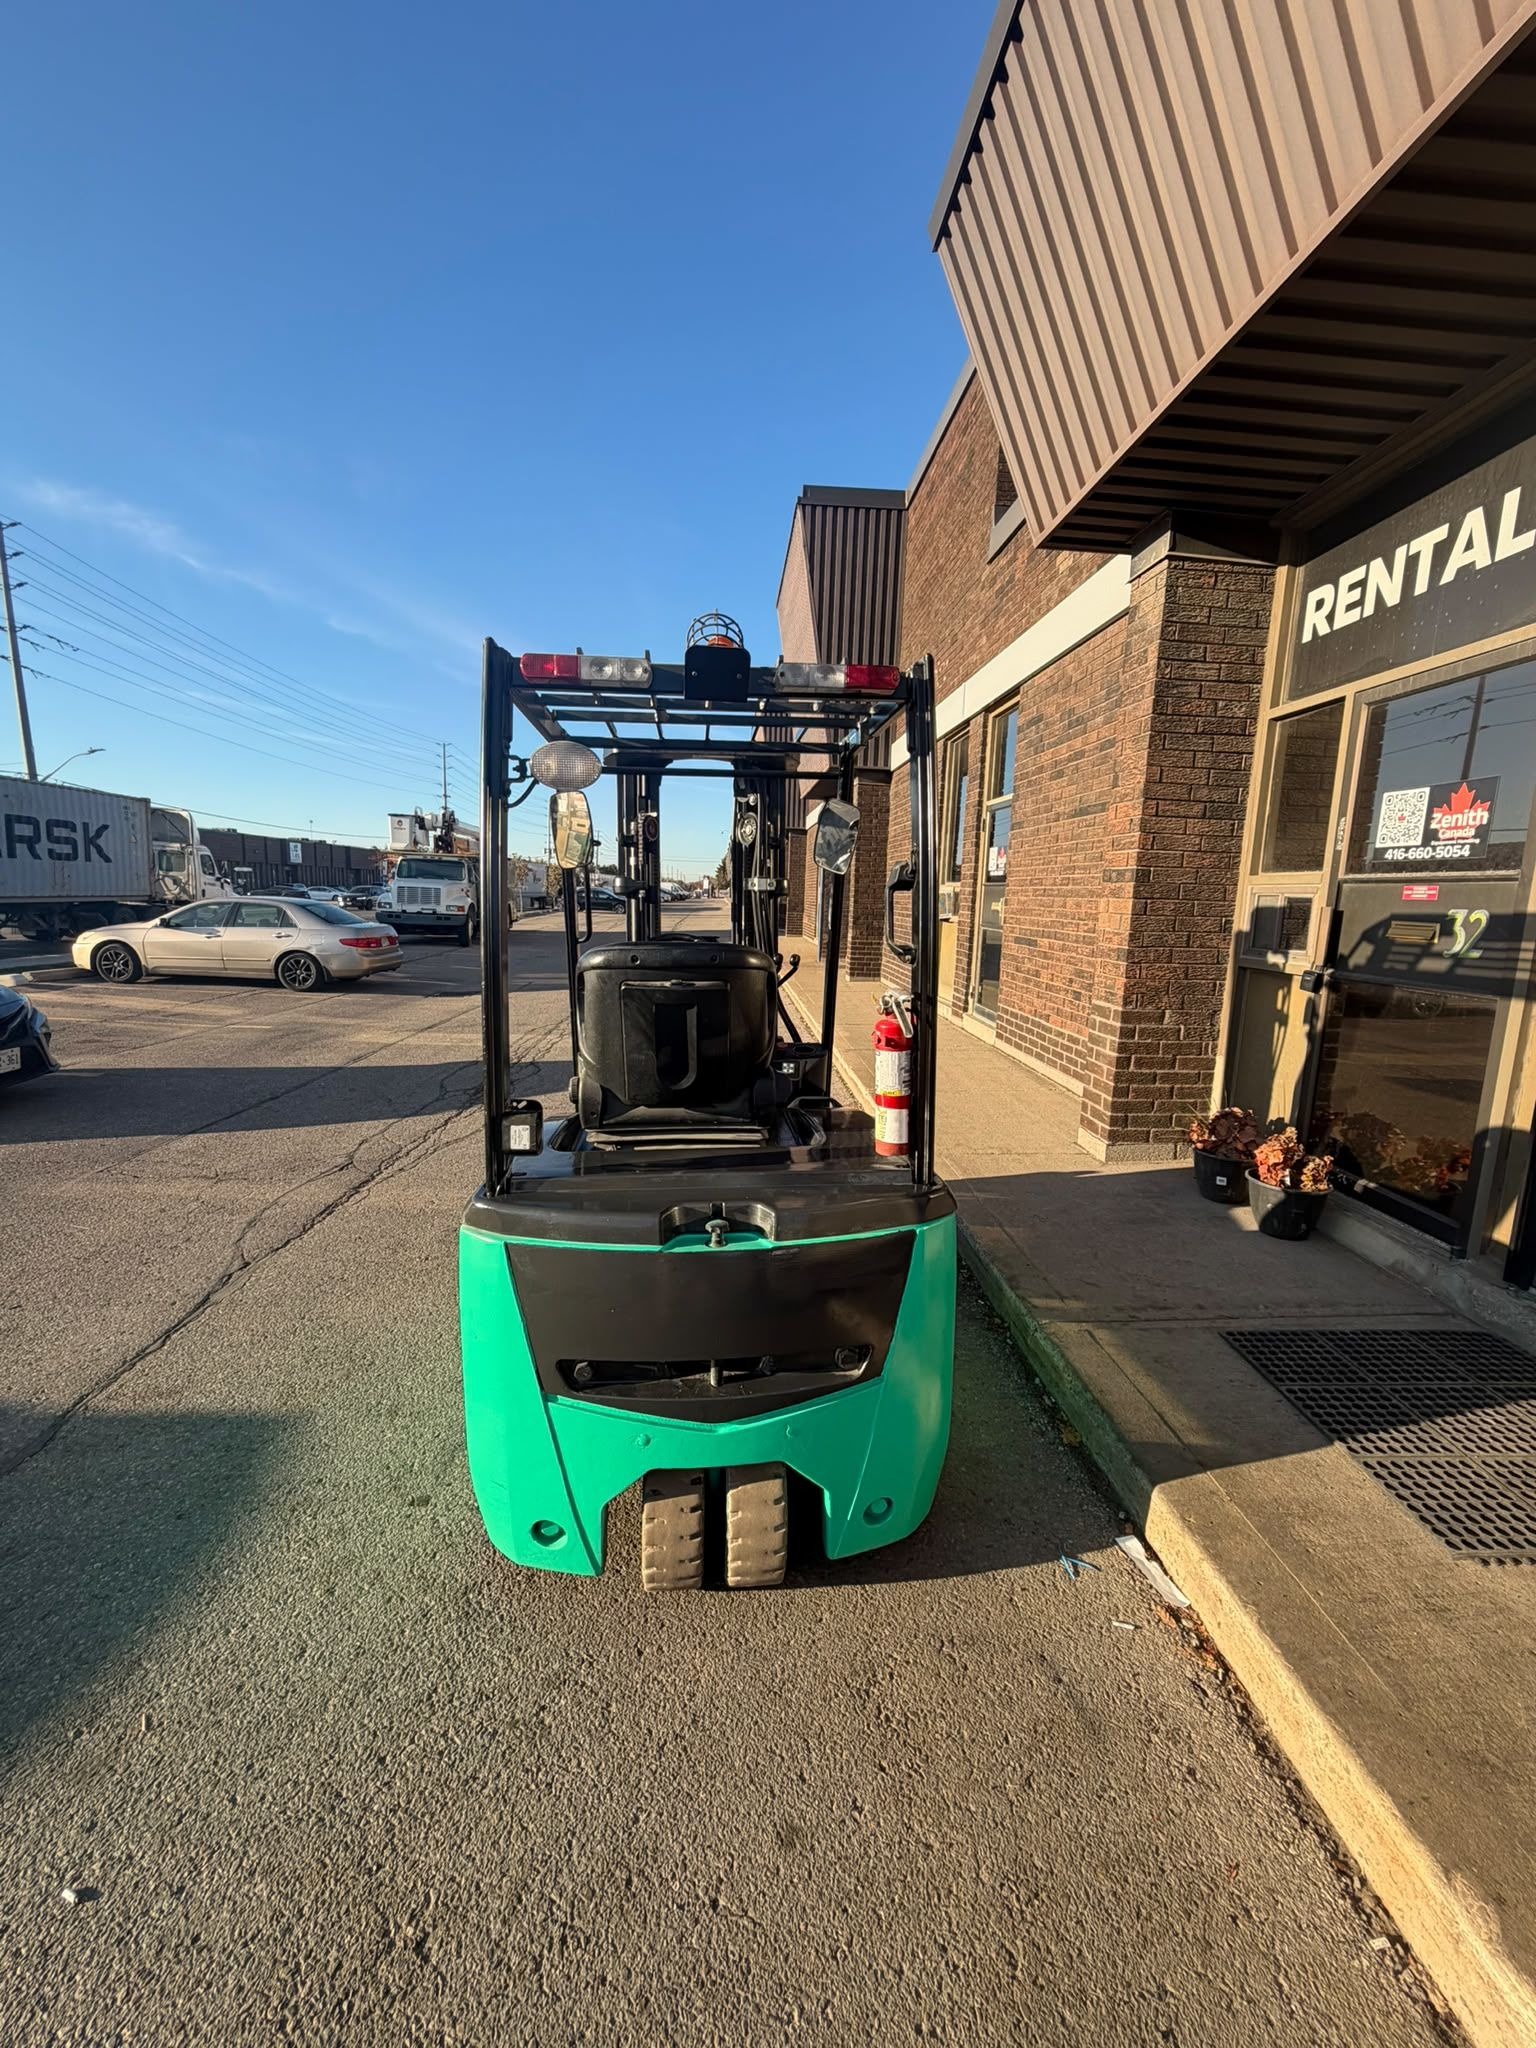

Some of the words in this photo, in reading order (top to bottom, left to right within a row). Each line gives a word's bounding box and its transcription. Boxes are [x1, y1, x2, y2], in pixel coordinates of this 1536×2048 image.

[1302, 486, 1536, 644] RENTAL
[1430, 808, 1489, 829] Zenith
[1439, 827, 1476, 838] Canada
[0, 813, 112, 863] RSK
[1384, 844, 1471, 860] 416-660-5054
[1442, 909, 1490, 958] 32
